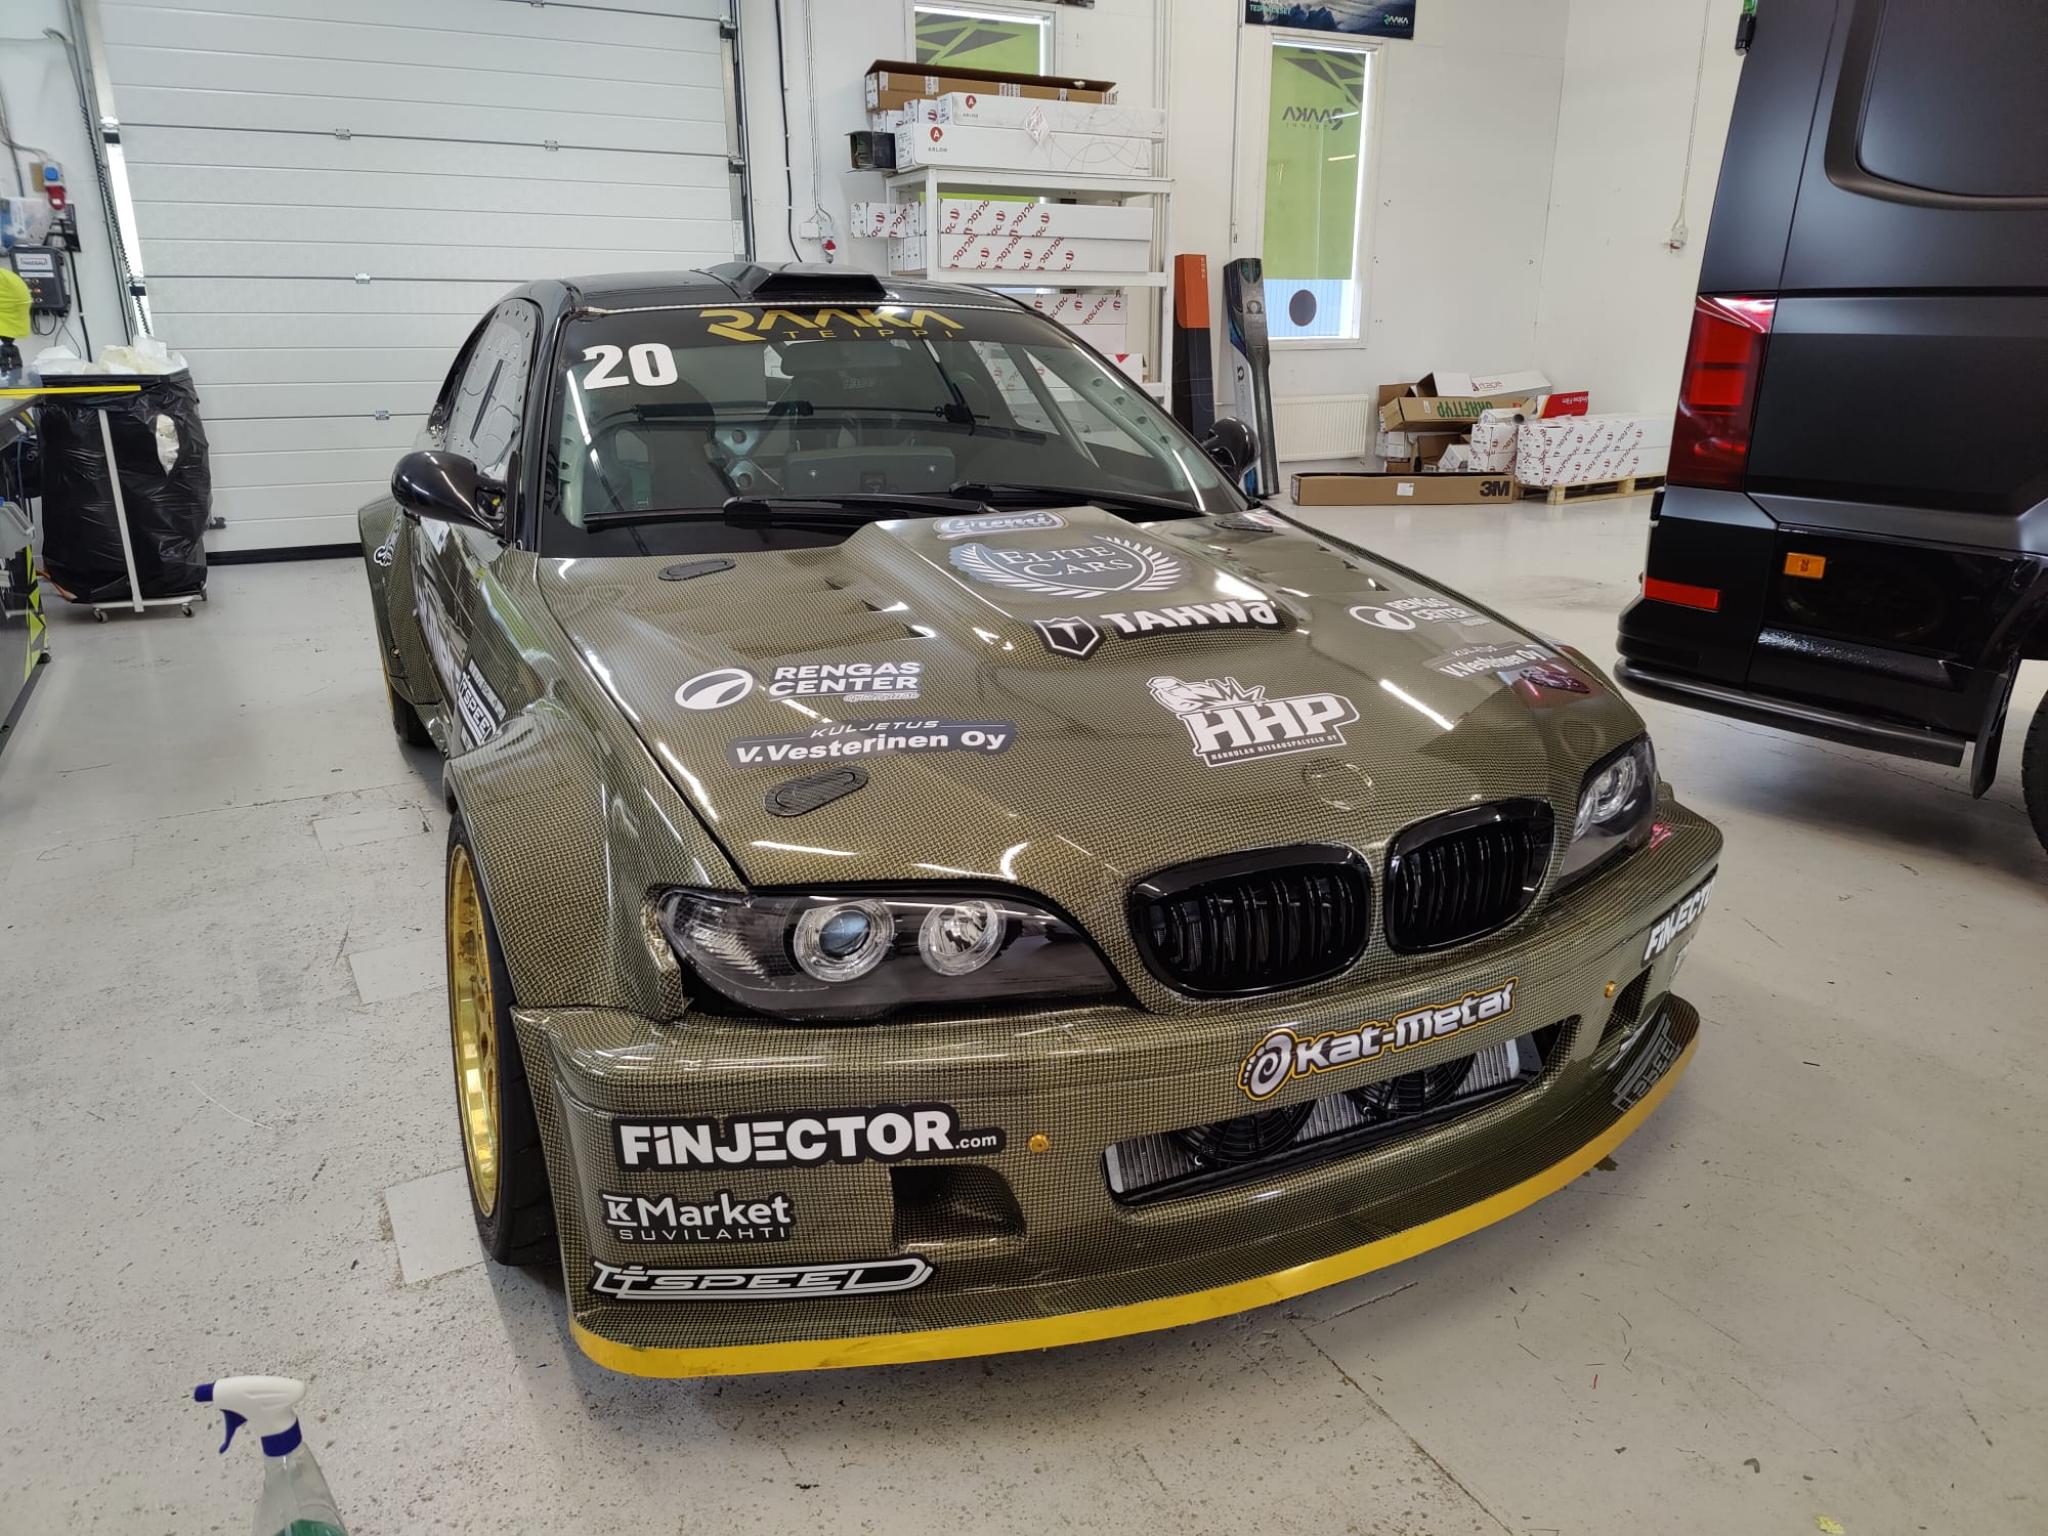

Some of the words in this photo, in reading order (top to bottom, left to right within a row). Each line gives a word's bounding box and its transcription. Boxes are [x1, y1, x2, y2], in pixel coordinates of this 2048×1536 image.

[698, 308, 965, 341] RAAKA
[783, 329, 954, 339] TEIPPI
[582, 343, 679, 389] 20
[1480, 481, 1510, 497] 3M
[992, 545, 1116, 565] ELITE
[1023, 559, 1133, 577] CARS
[774, 662, 921, 680] RENGAS
[769, 677, 918, 696] CENTER
[810, 720, 940, 738] KULJETUS
[1181, 695, 1346, 752] HHP
[735, 733, 949, 763] V.Vesterinen
[960, 730, 1007, 750] Oy
[619, 1227, 786, 1241] SUVILAHTI
